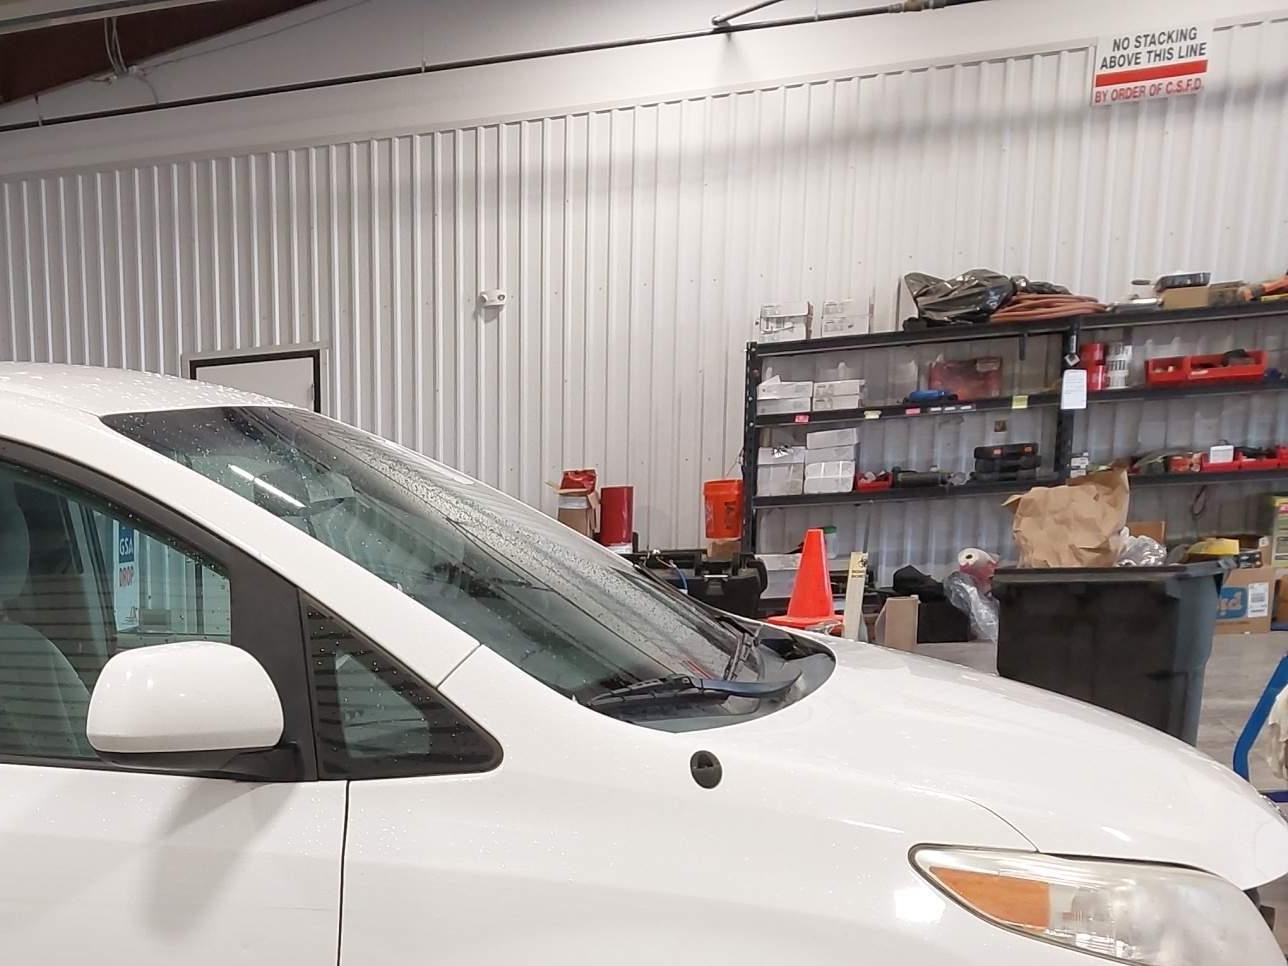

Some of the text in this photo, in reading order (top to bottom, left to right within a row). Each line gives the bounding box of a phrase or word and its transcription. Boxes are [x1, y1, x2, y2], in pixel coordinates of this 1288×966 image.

[1112, 27, 1198, 52] NO STACKING
[1100, 42, 1207, 70] ABOVE THIS LINE
[1095, 90, 1108, 104] BY
[1111, 84, 1146, 101] ORDER
[1149, 82, 1163, 97] OF
